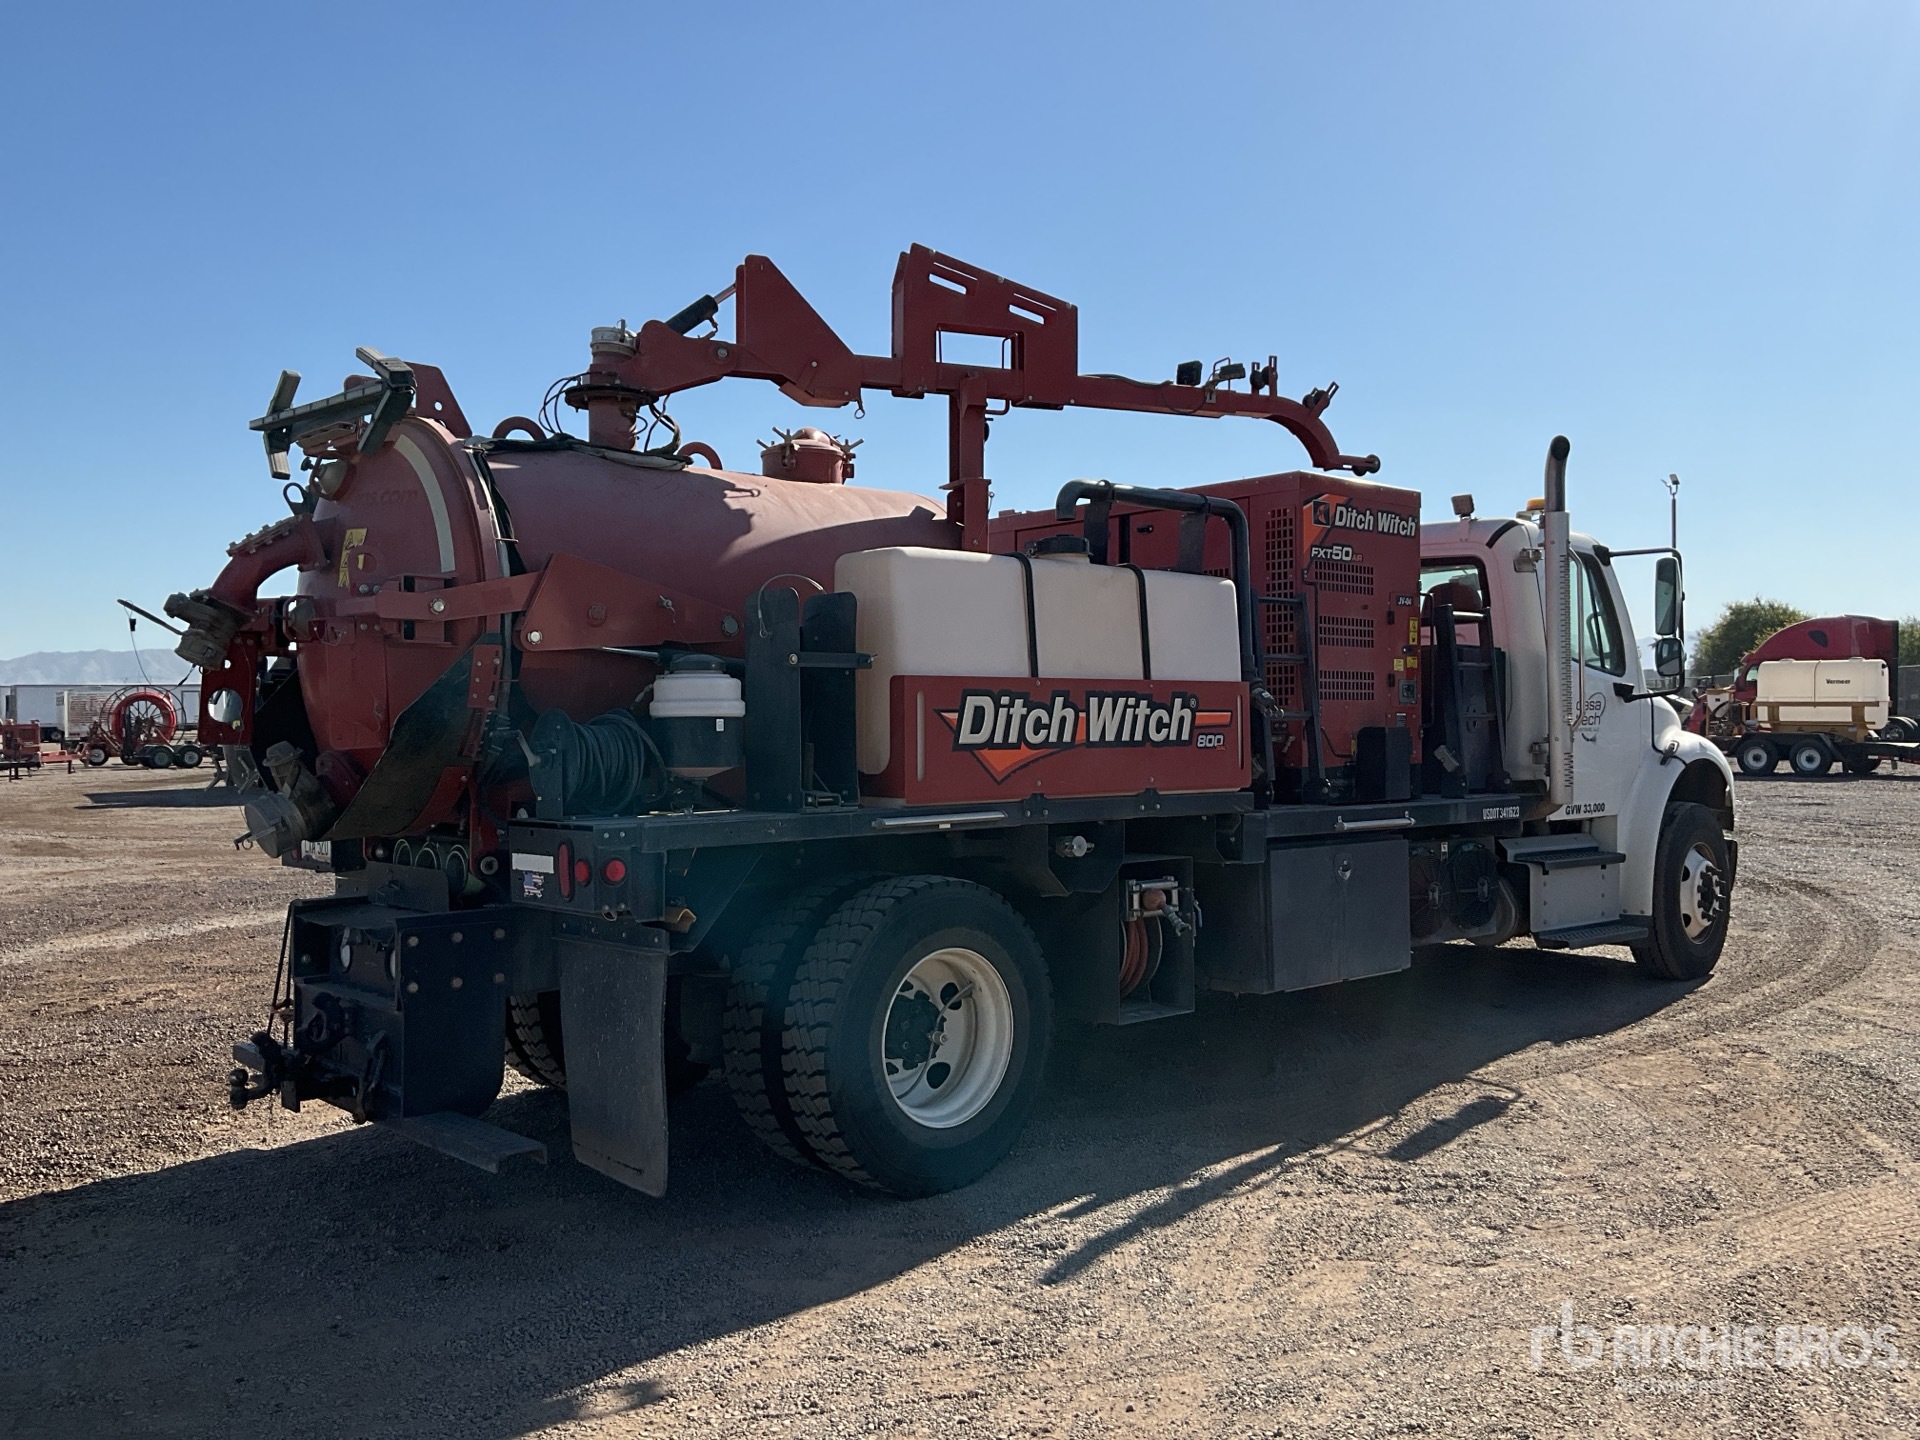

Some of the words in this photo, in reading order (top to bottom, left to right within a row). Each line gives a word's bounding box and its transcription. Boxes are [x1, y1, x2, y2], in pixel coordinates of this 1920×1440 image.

[1334, 506, 1374, 531] Ditch
[1377, 511, 1416, 537] Witch
[1311, 545, 1352, 561] FXT50
[958, 695, 1076, 744] Ditch
[1088, 697, 1192, 742] Witch
[1197, 734, 1224, 748] 800
[1482, 807, 1499, 820] USDOT
[1565, 804, 1581, 815] GVW
[1583, 802, 1606, 815] 33,000
